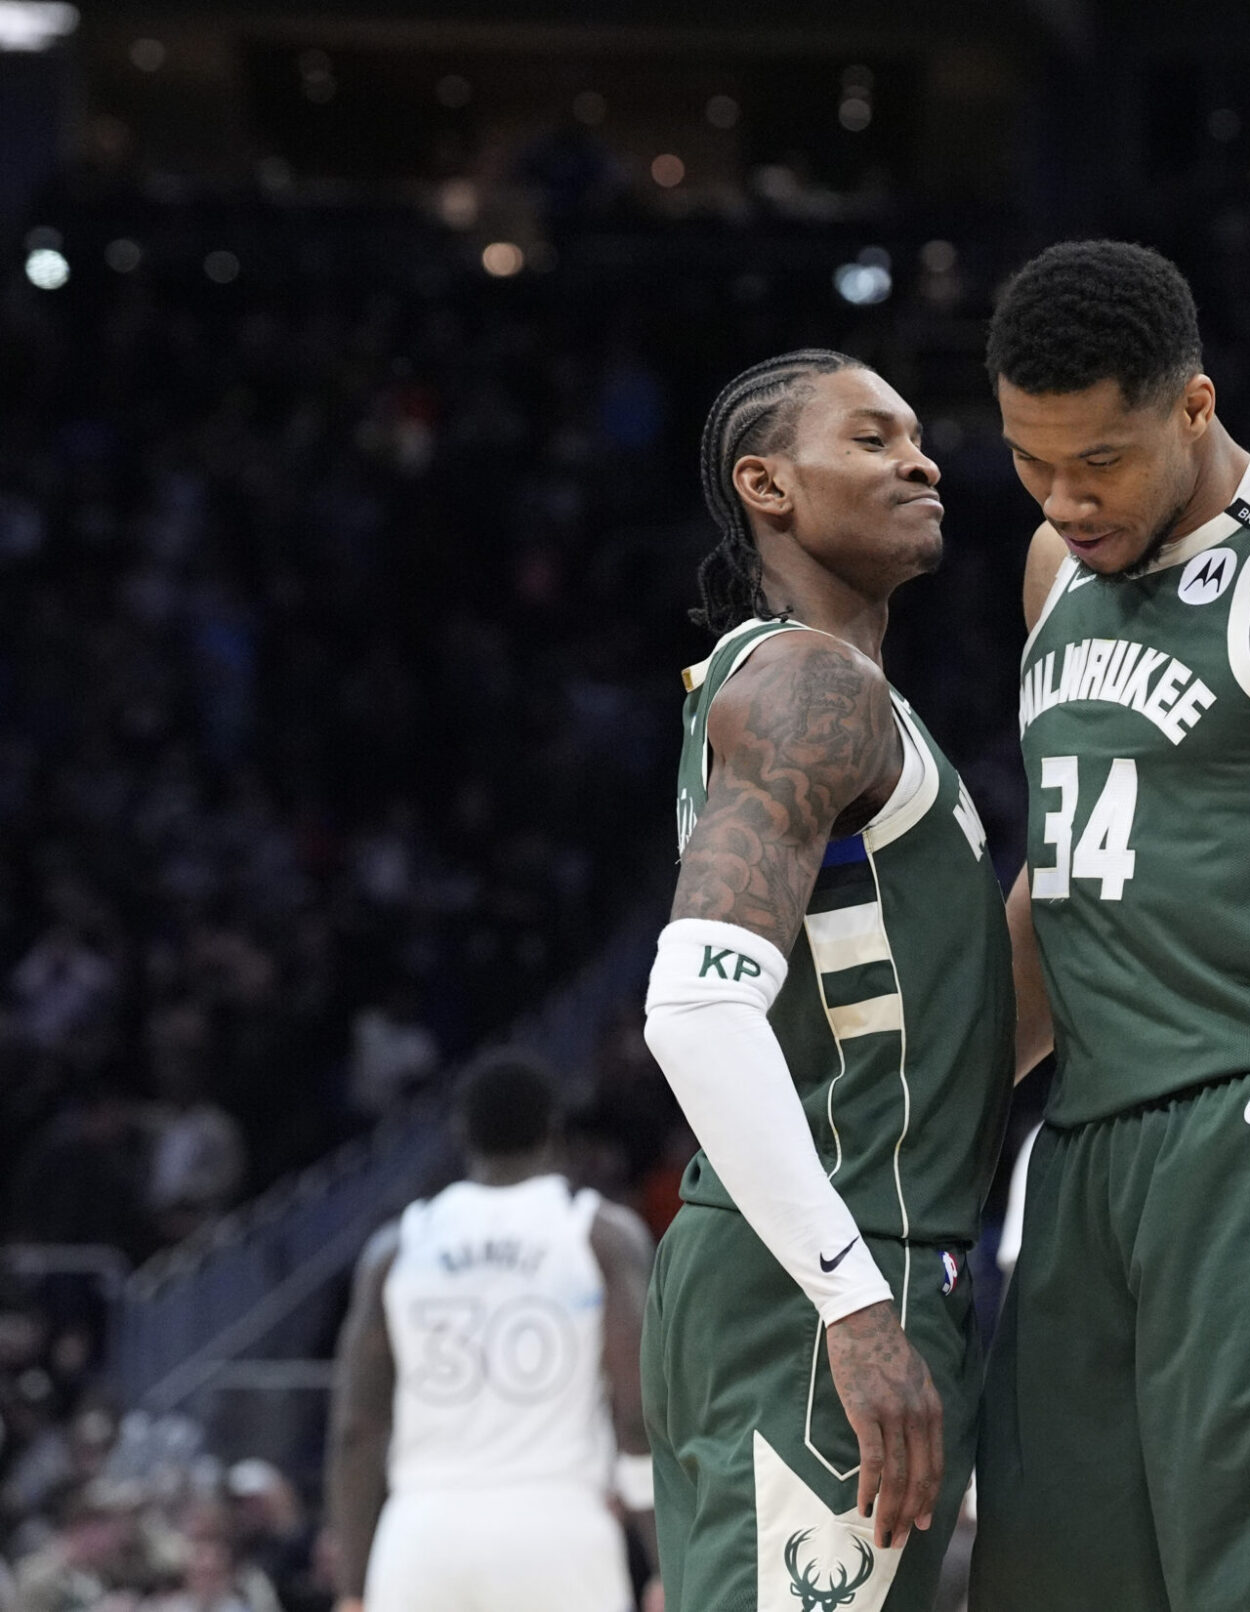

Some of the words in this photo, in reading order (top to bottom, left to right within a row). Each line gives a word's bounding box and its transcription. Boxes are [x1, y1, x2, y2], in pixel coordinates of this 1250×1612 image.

[1019, 638, 1217, 745] MILWAUKEE
[1031, 755, 1138, 901] 34
[699, 945, 761, 982] KP
[404, 1298, 576, 1406] 30
